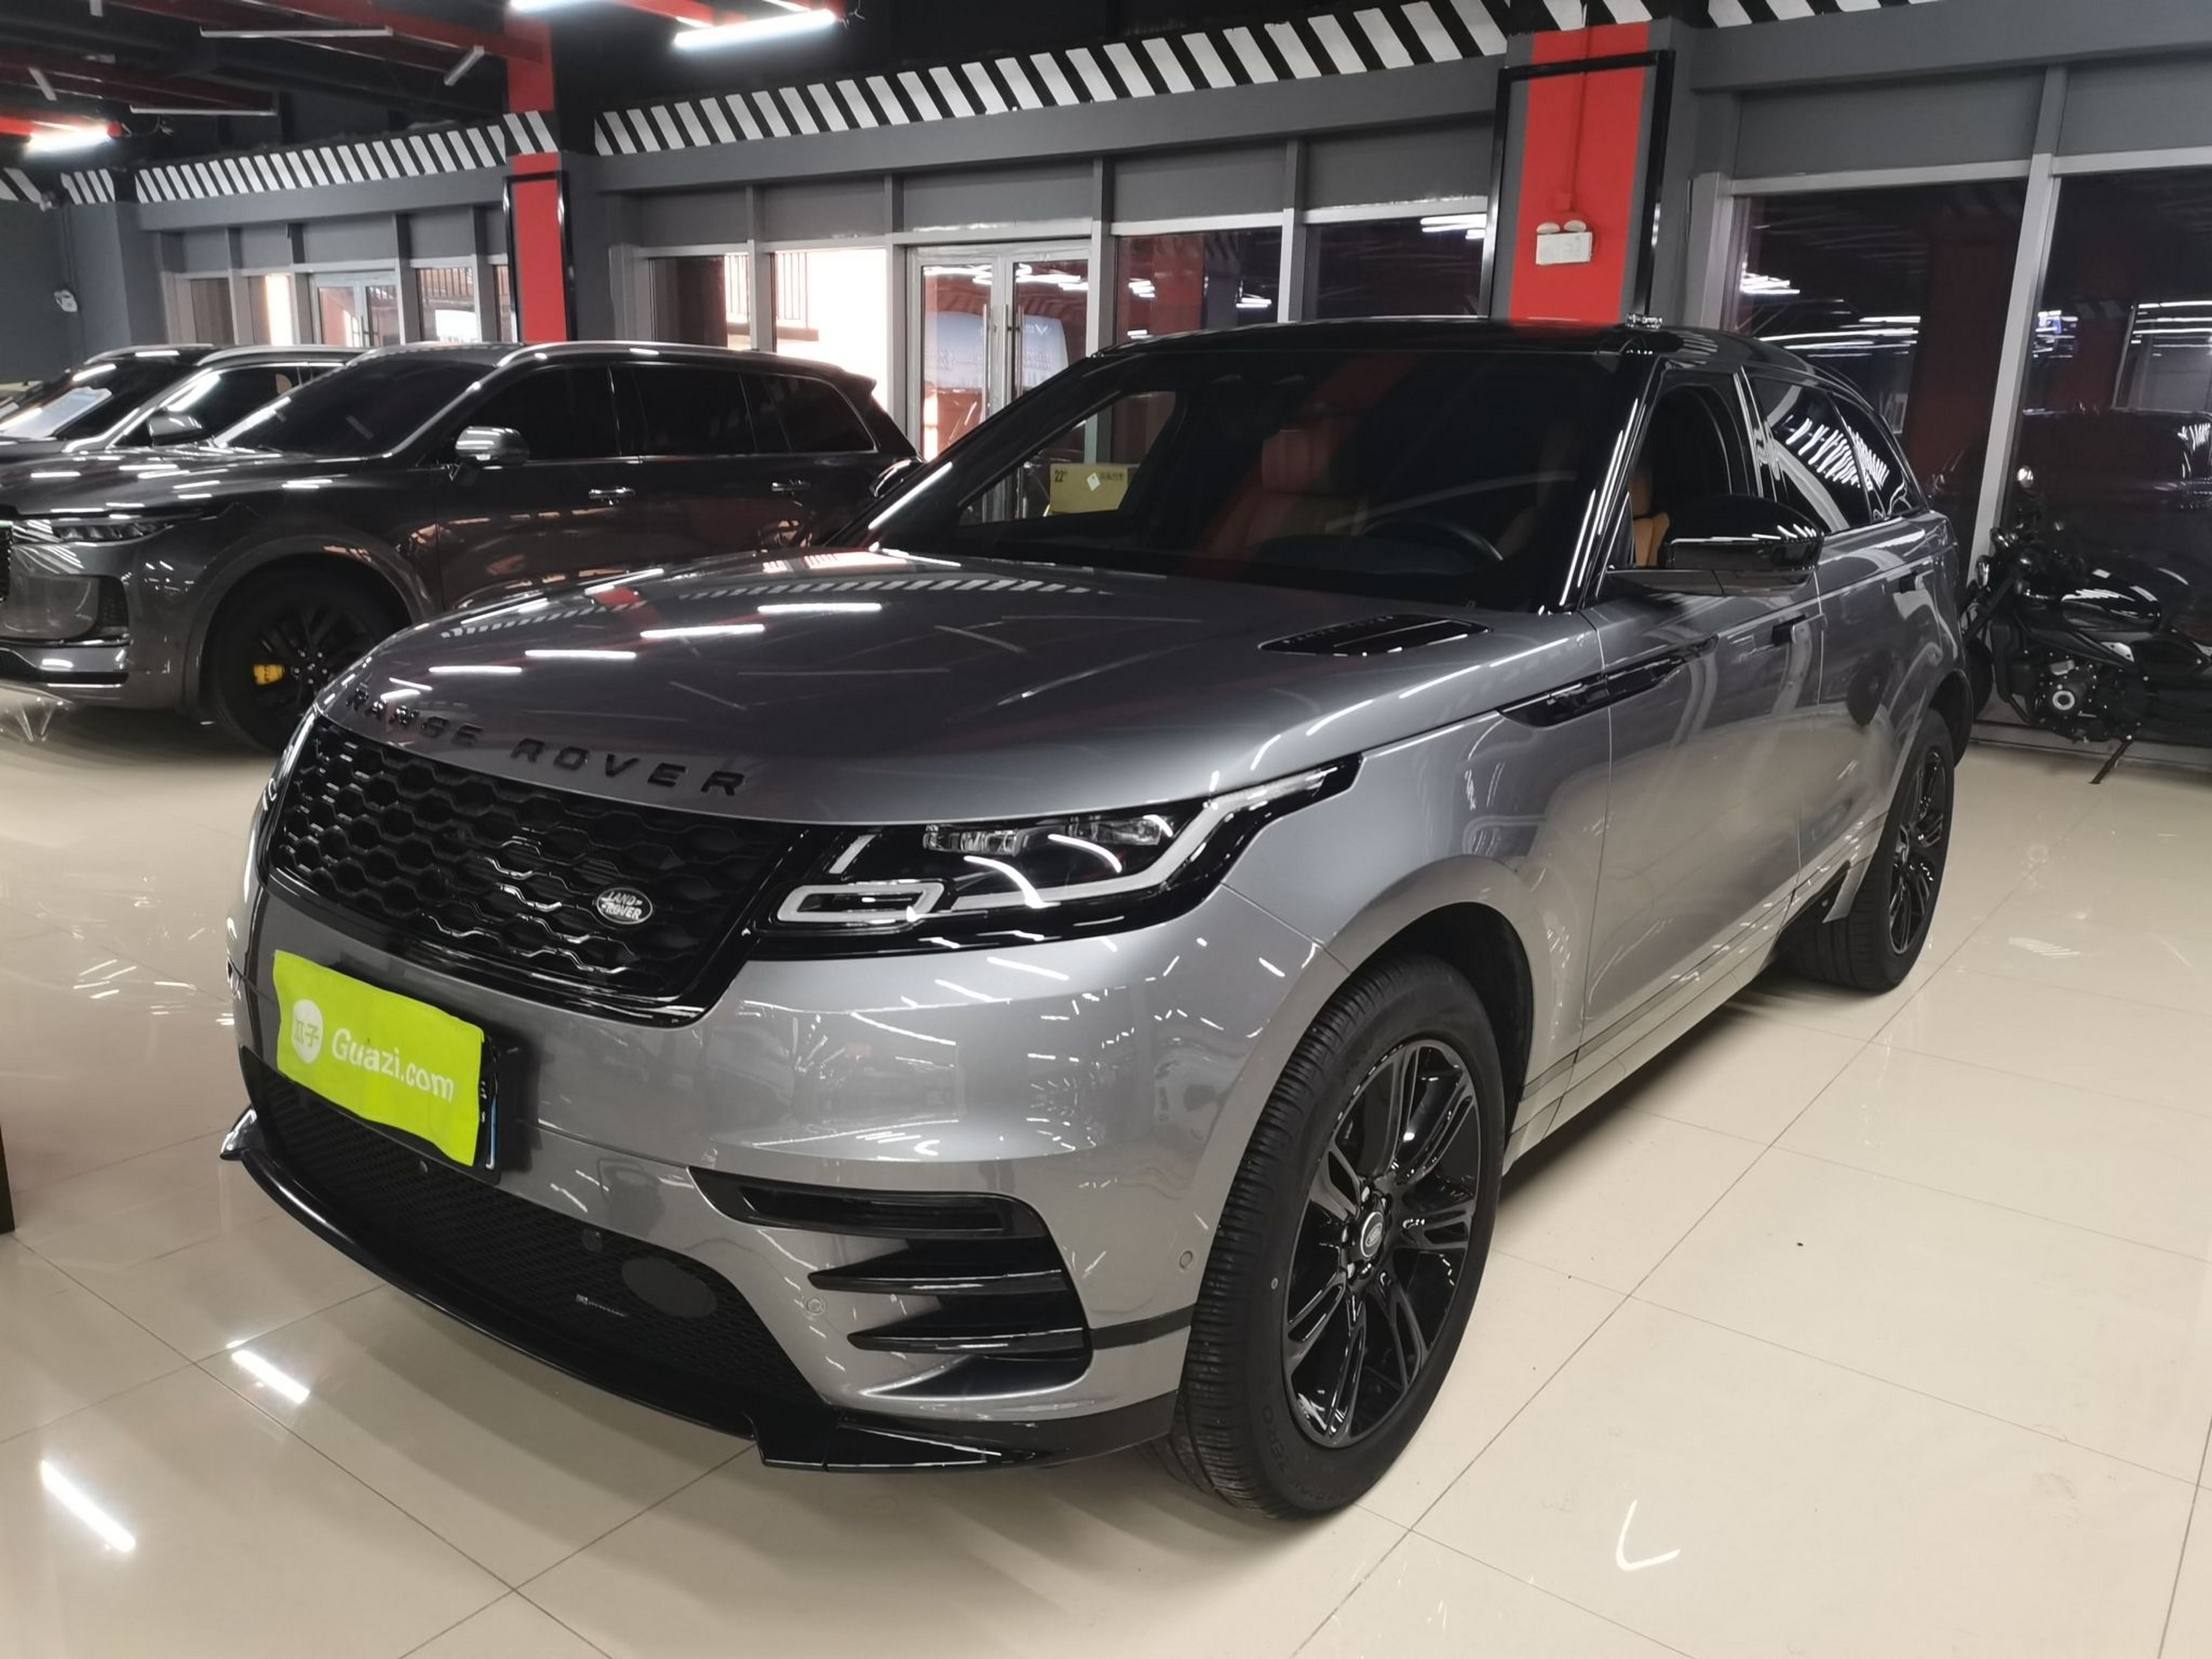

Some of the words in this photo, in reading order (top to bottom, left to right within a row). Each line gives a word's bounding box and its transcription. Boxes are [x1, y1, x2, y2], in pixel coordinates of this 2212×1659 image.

[510, 737, 745, 797] ROVER
[605, 902, 642, 920] ROVER
[331, 1027, 454, 1104] Guazi.com
